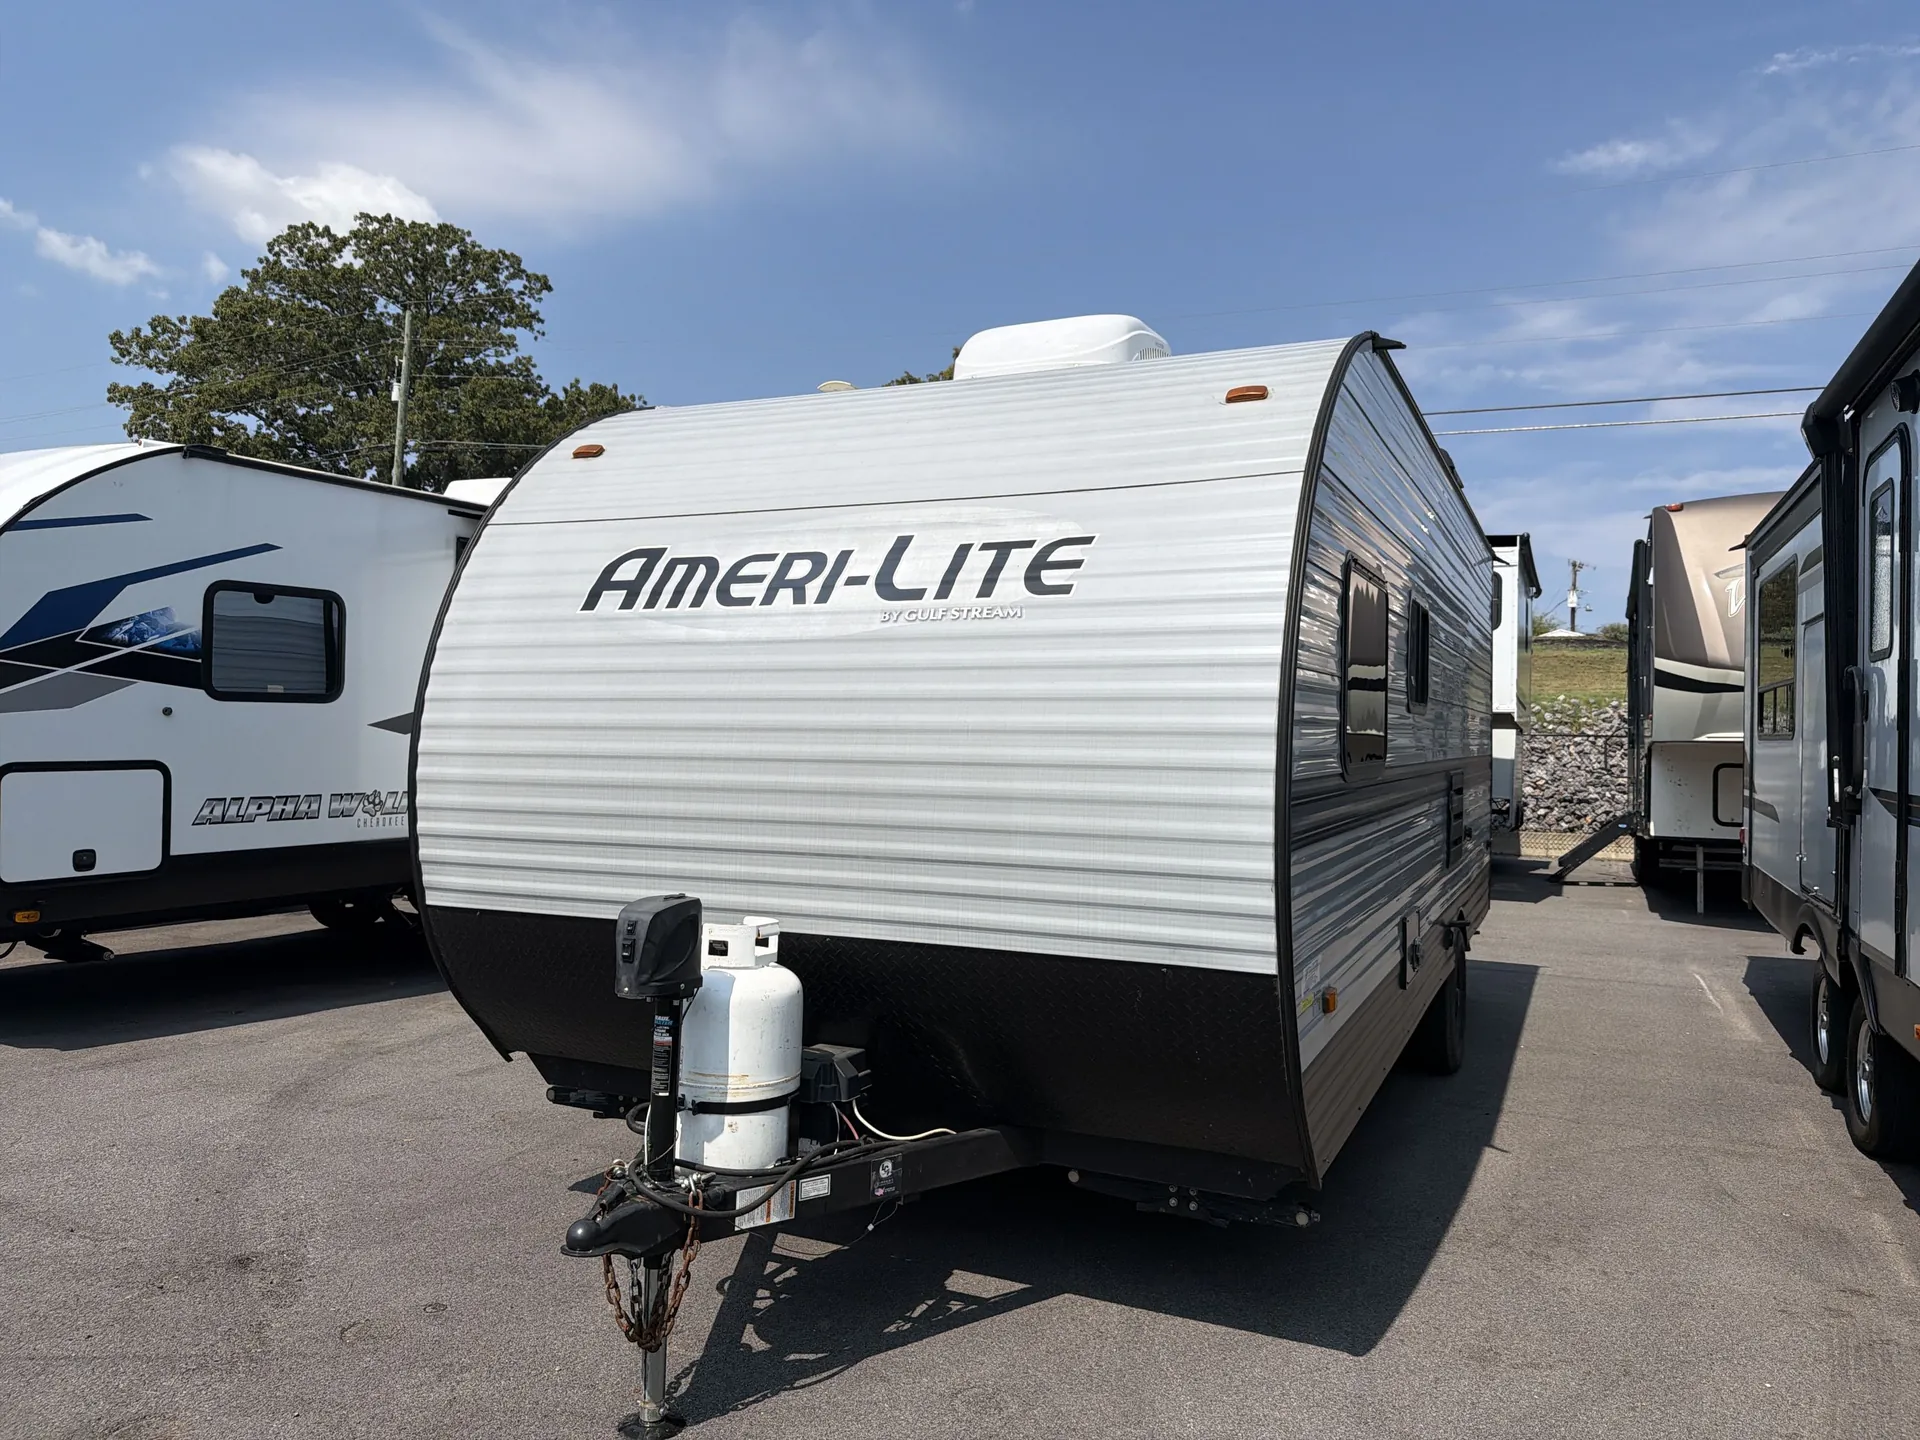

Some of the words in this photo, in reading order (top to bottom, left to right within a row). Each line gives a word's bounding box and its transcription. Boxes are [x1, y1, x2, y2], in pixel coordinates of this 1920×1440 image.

[579, 535, 1096, 611] AMERI-LITE
[880, 610, 901, 623] BY
[904, 608, 947, 622] GULF
[949, 604, 1023, 620] STREAM
[191, 794, 322, 826] ALPHA
[356, 815, 405, 829] CHEROKEE
